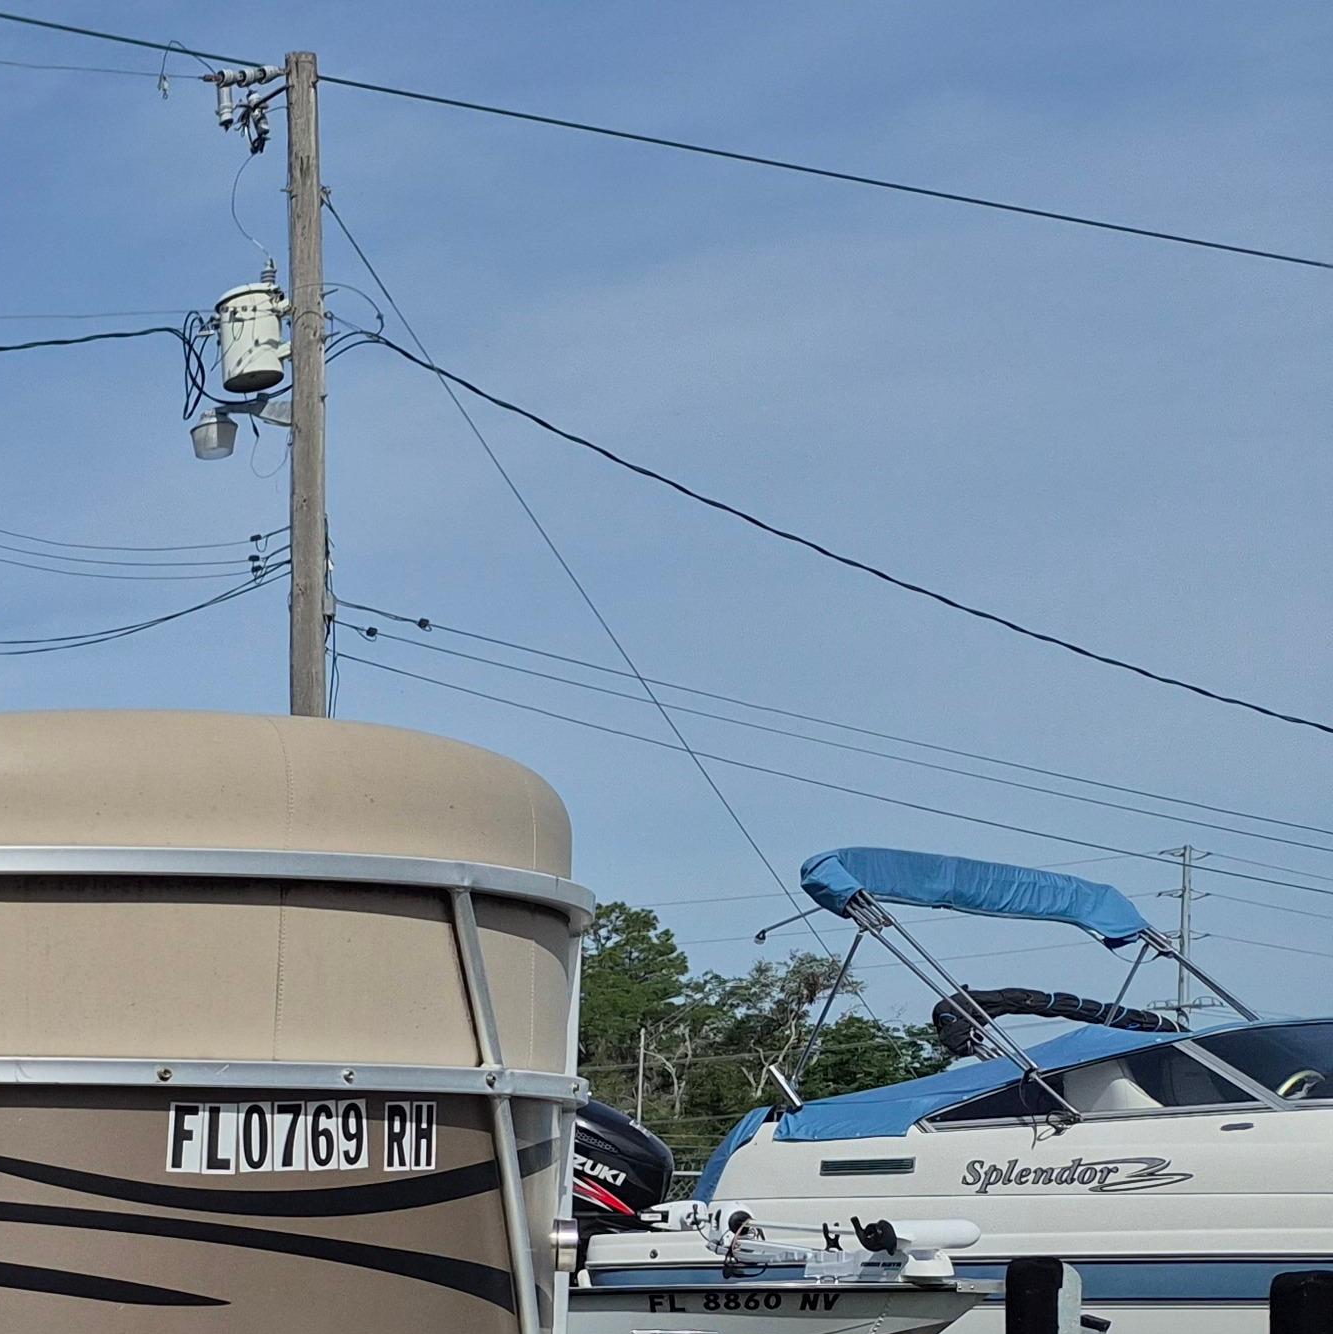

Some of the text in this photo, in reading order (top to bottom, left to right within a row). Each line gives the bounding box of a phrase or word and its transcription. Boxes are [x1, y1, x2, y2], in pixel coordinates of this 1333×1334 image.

[386, 1103, 434, 1168] RH
[961, 1158, 1120, 1194] Splendor
[649, 1293, 840, 1313] FL 8860 NV
